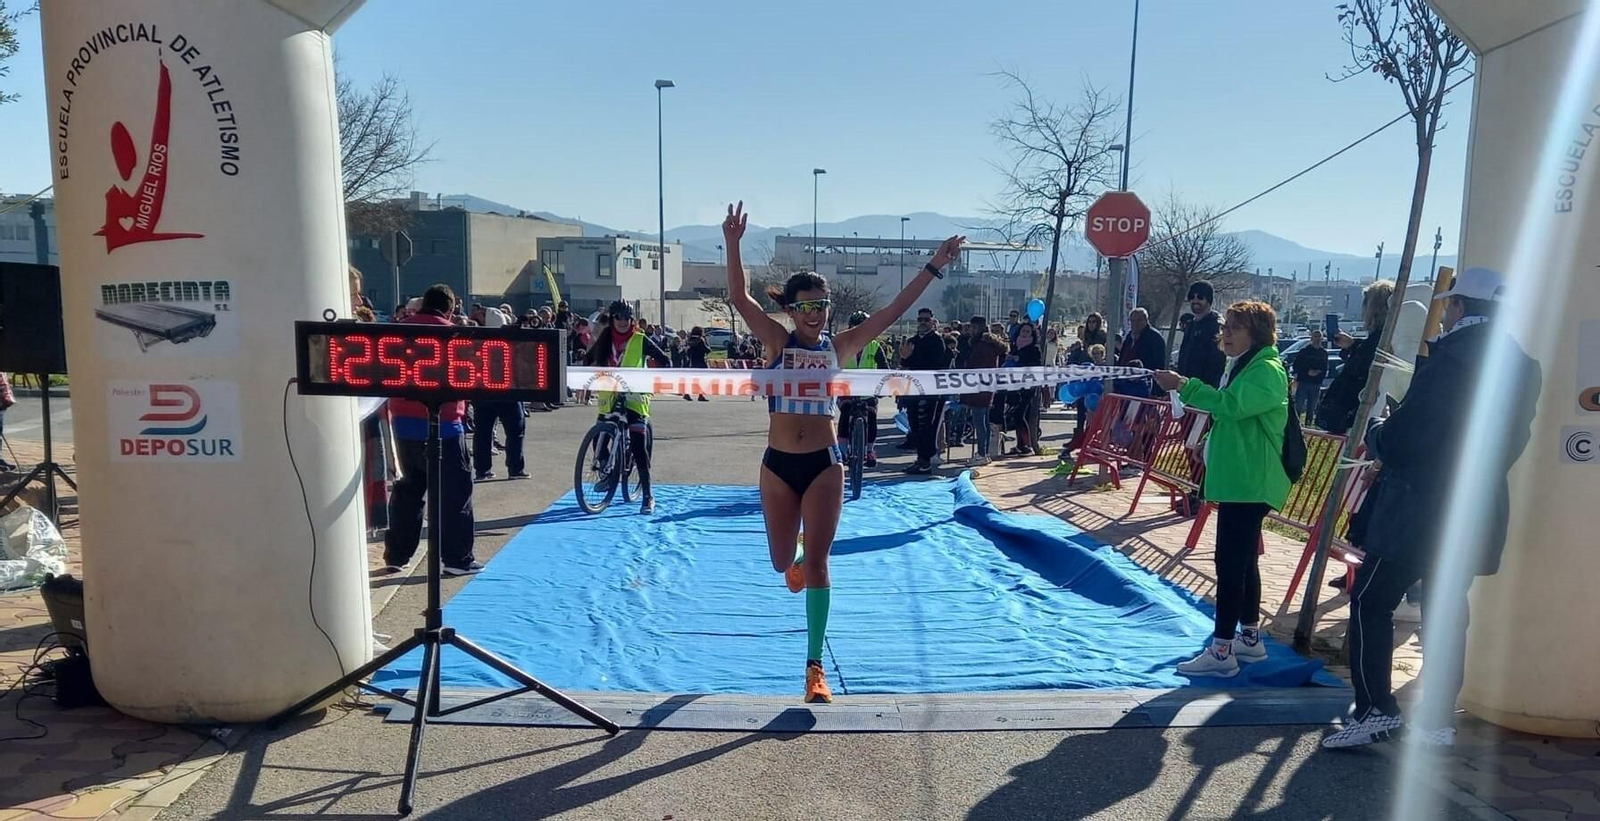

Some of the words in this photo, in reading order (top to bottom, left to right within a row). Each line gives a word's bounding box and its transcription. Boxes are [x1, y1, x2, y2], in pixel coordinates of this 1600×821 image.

[58, 89, 74, 180] ESCUELA
[66, 22, 162, 87] PROVINCIAL
[168, 34, 200, 65] DE
[192, 64, 240, 177] ATLETISMO
[1555, 122, 1600, 214] ESCUELA
[135, 180, 159, 231] MIGUEL
[149, 143, 167, 176] RIOS
[1092, 216, 1145, 233] STOP
[101, 280, 230, 305] MORECINTA
[933, 372, 1037, 390] ESCUELA
[120, 438, 234, 456] DEPOSUR
